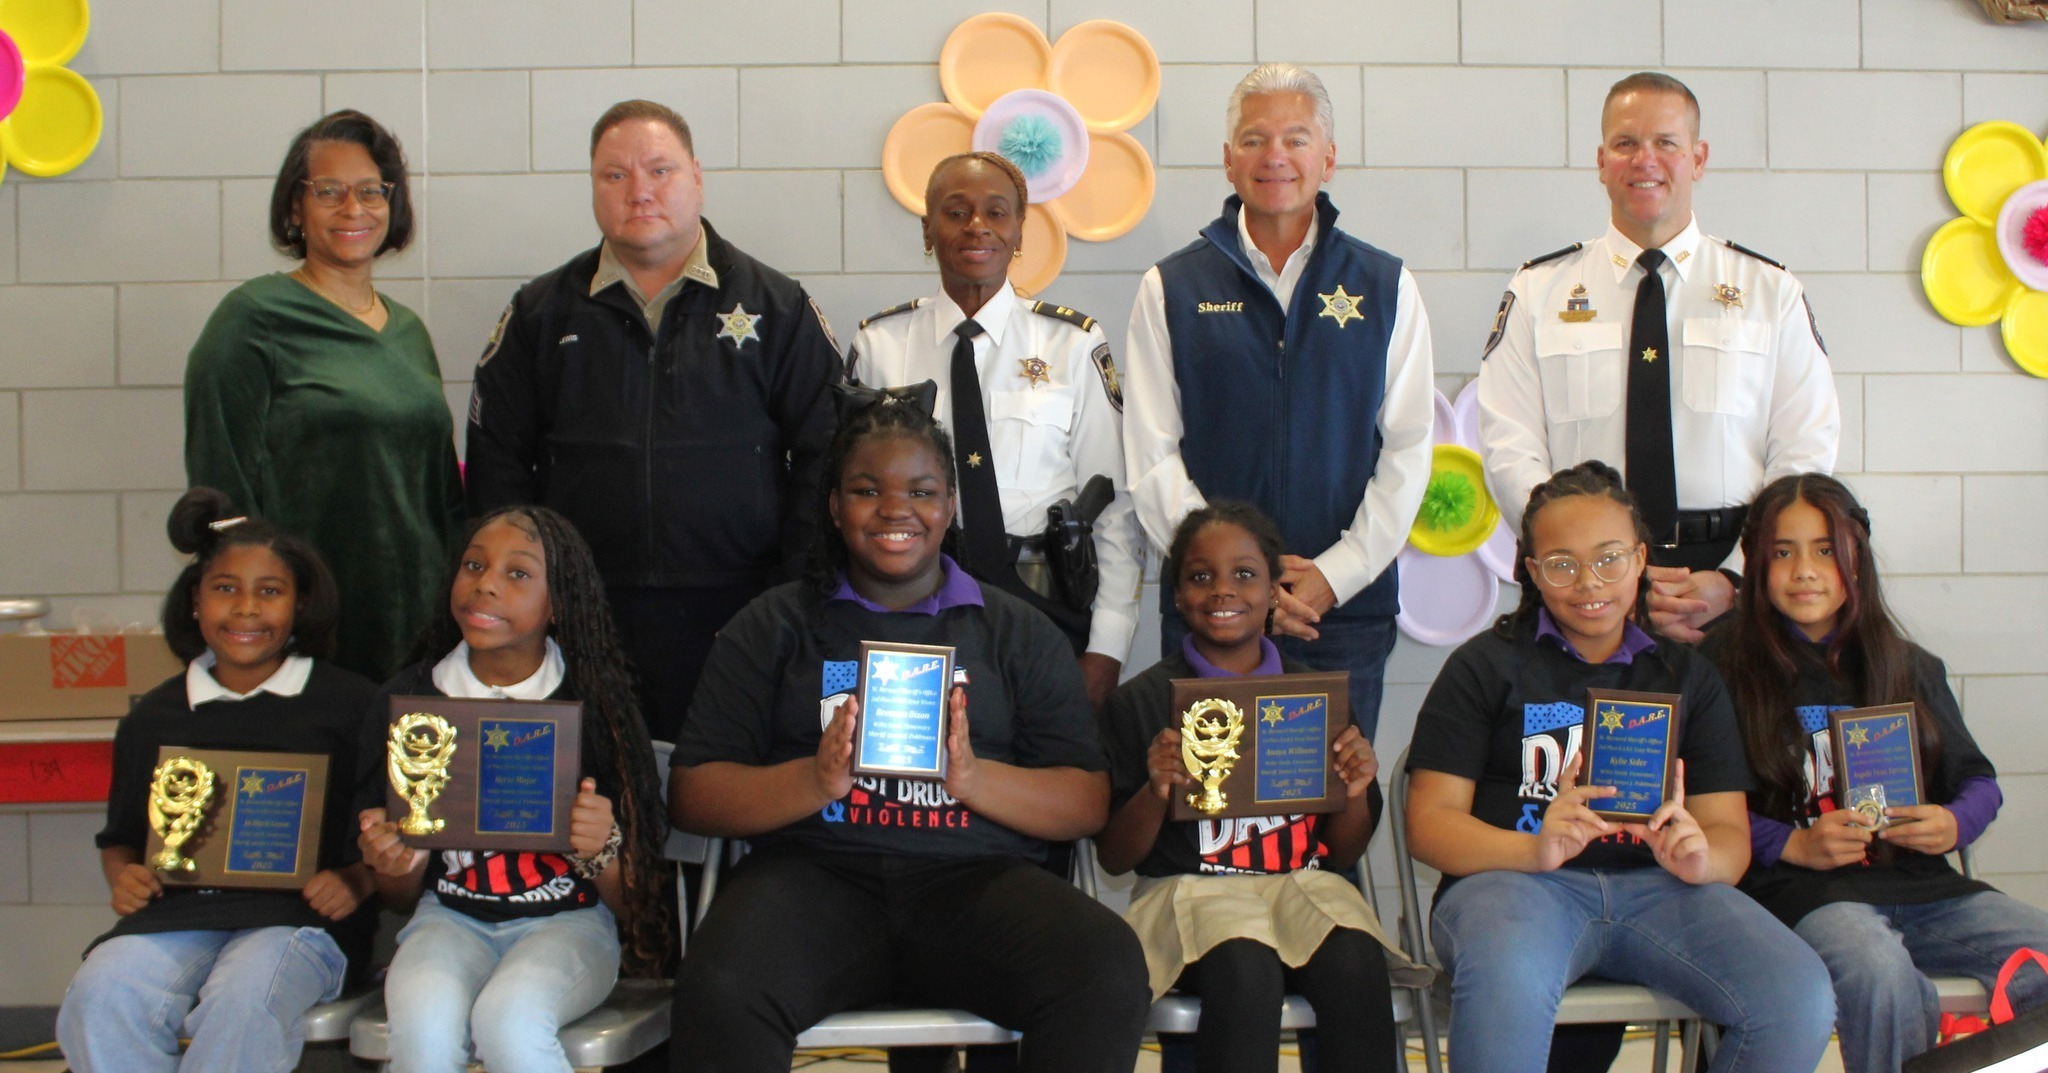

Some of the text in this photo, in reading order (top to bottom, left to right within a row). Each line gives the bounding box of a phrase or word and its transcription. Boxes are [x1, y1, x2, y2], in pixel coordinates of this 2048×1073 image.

[1198, 301, 1244, 313] Sheriff
[908, 709, 929, 719] Dixon
[1288, 746, 1317, 754] Williams
[1628, 757, 1648, 766] Sider
[1281, 788, 1301, 796] 2025
[1614, 800, 1636, 809] 2025
[850, 807, 969, 827] VIOLENCE
